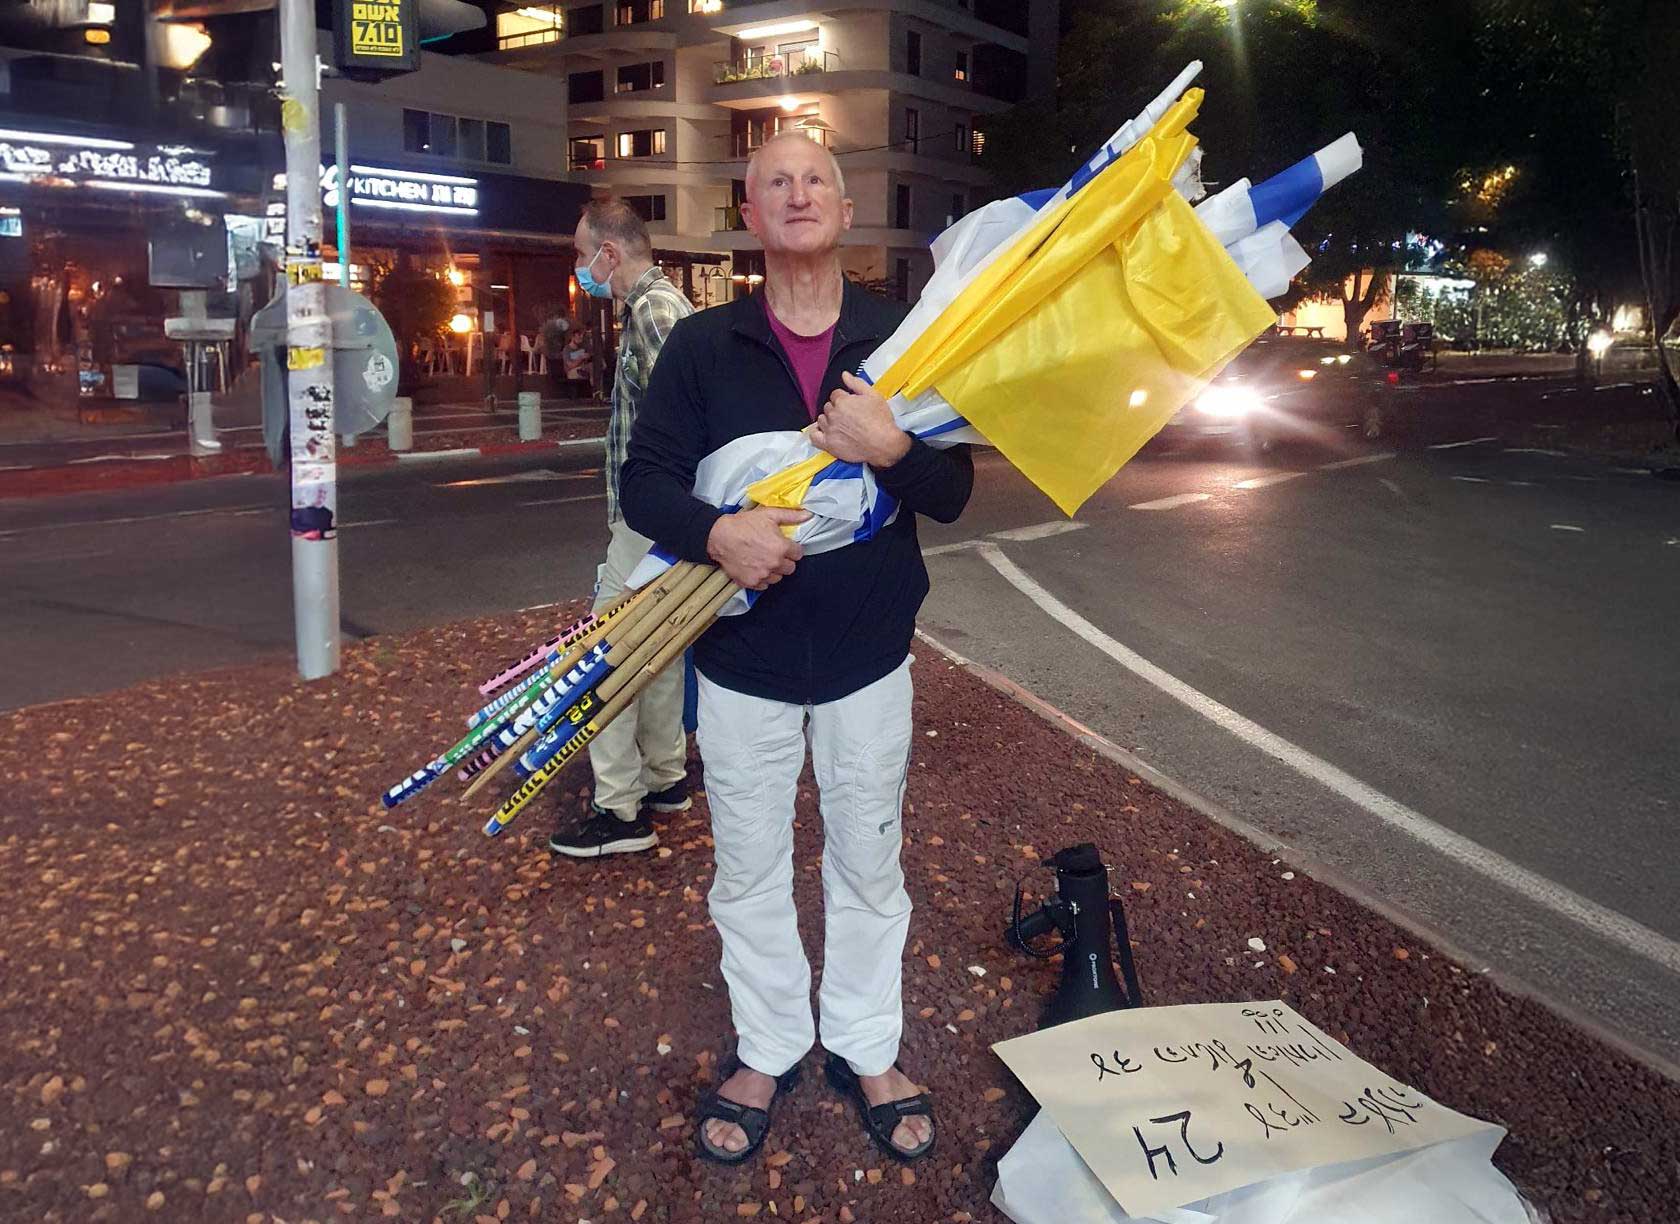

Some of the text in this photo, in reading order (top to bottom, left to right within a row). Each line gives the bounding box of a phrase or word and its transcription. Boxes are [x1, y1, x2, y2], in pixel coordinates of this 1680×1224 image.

[353, 4, 400, 21] אשם
[356, 22, 398, 43] 7.10
[354, 177, 428, 200] KITCHEN
[1090, 1050, 1143, 1081] עד
[1246, 1024, 1342, 1067] האחרון
[1132, 1071, 1424, 1181] 24 עדיין בעזה
